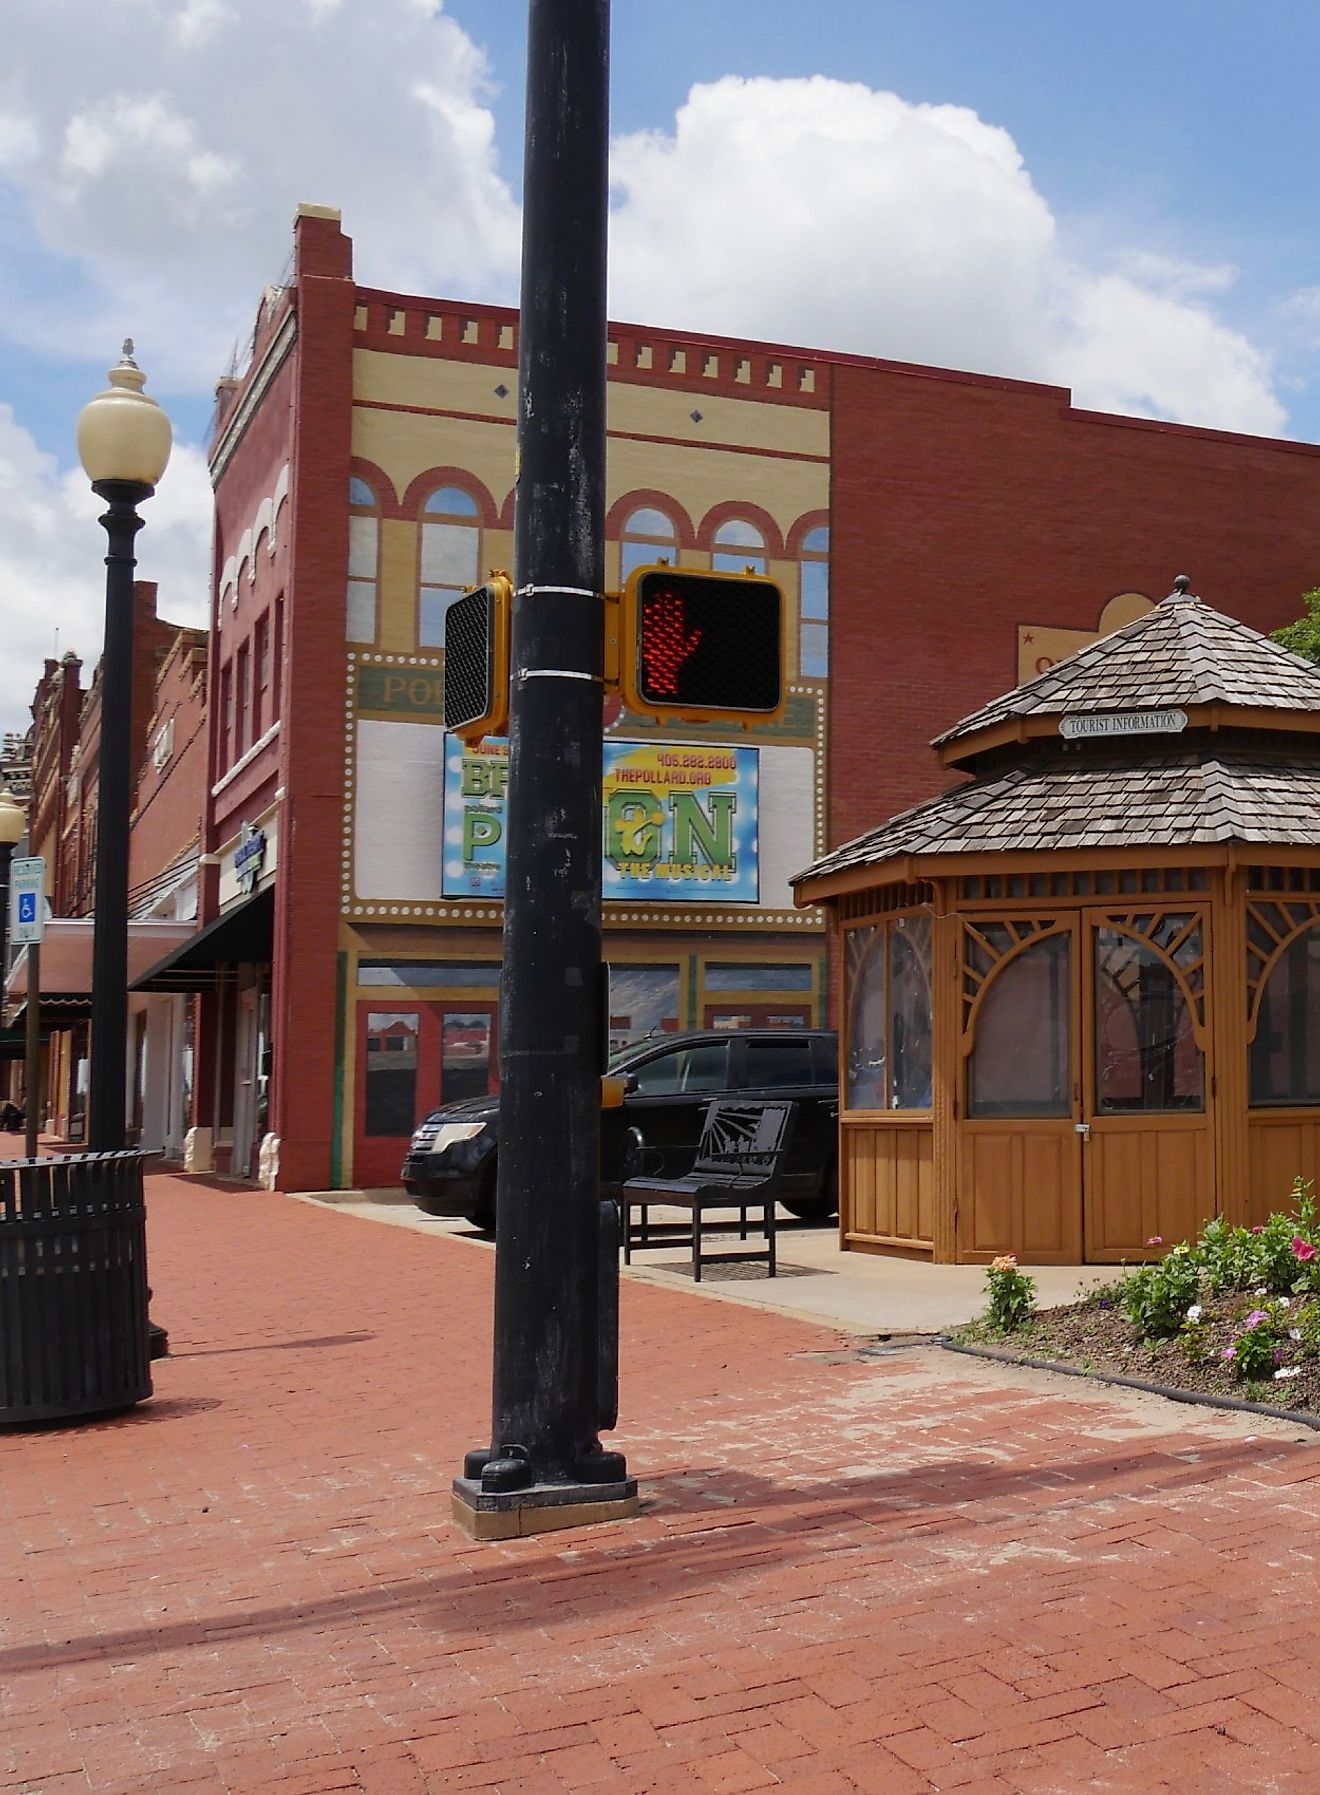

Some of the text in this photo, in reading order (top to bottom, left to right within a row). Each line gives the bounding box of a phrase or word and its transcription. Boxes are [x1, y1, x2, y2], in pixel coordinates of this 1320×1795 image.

[1069, 712, 1176, 733] TOURIST INFORMATION
[615, 768, 711, 785] THEPOLLARD.ORG
[618, 862, 732, 881] THE MUSICAL
